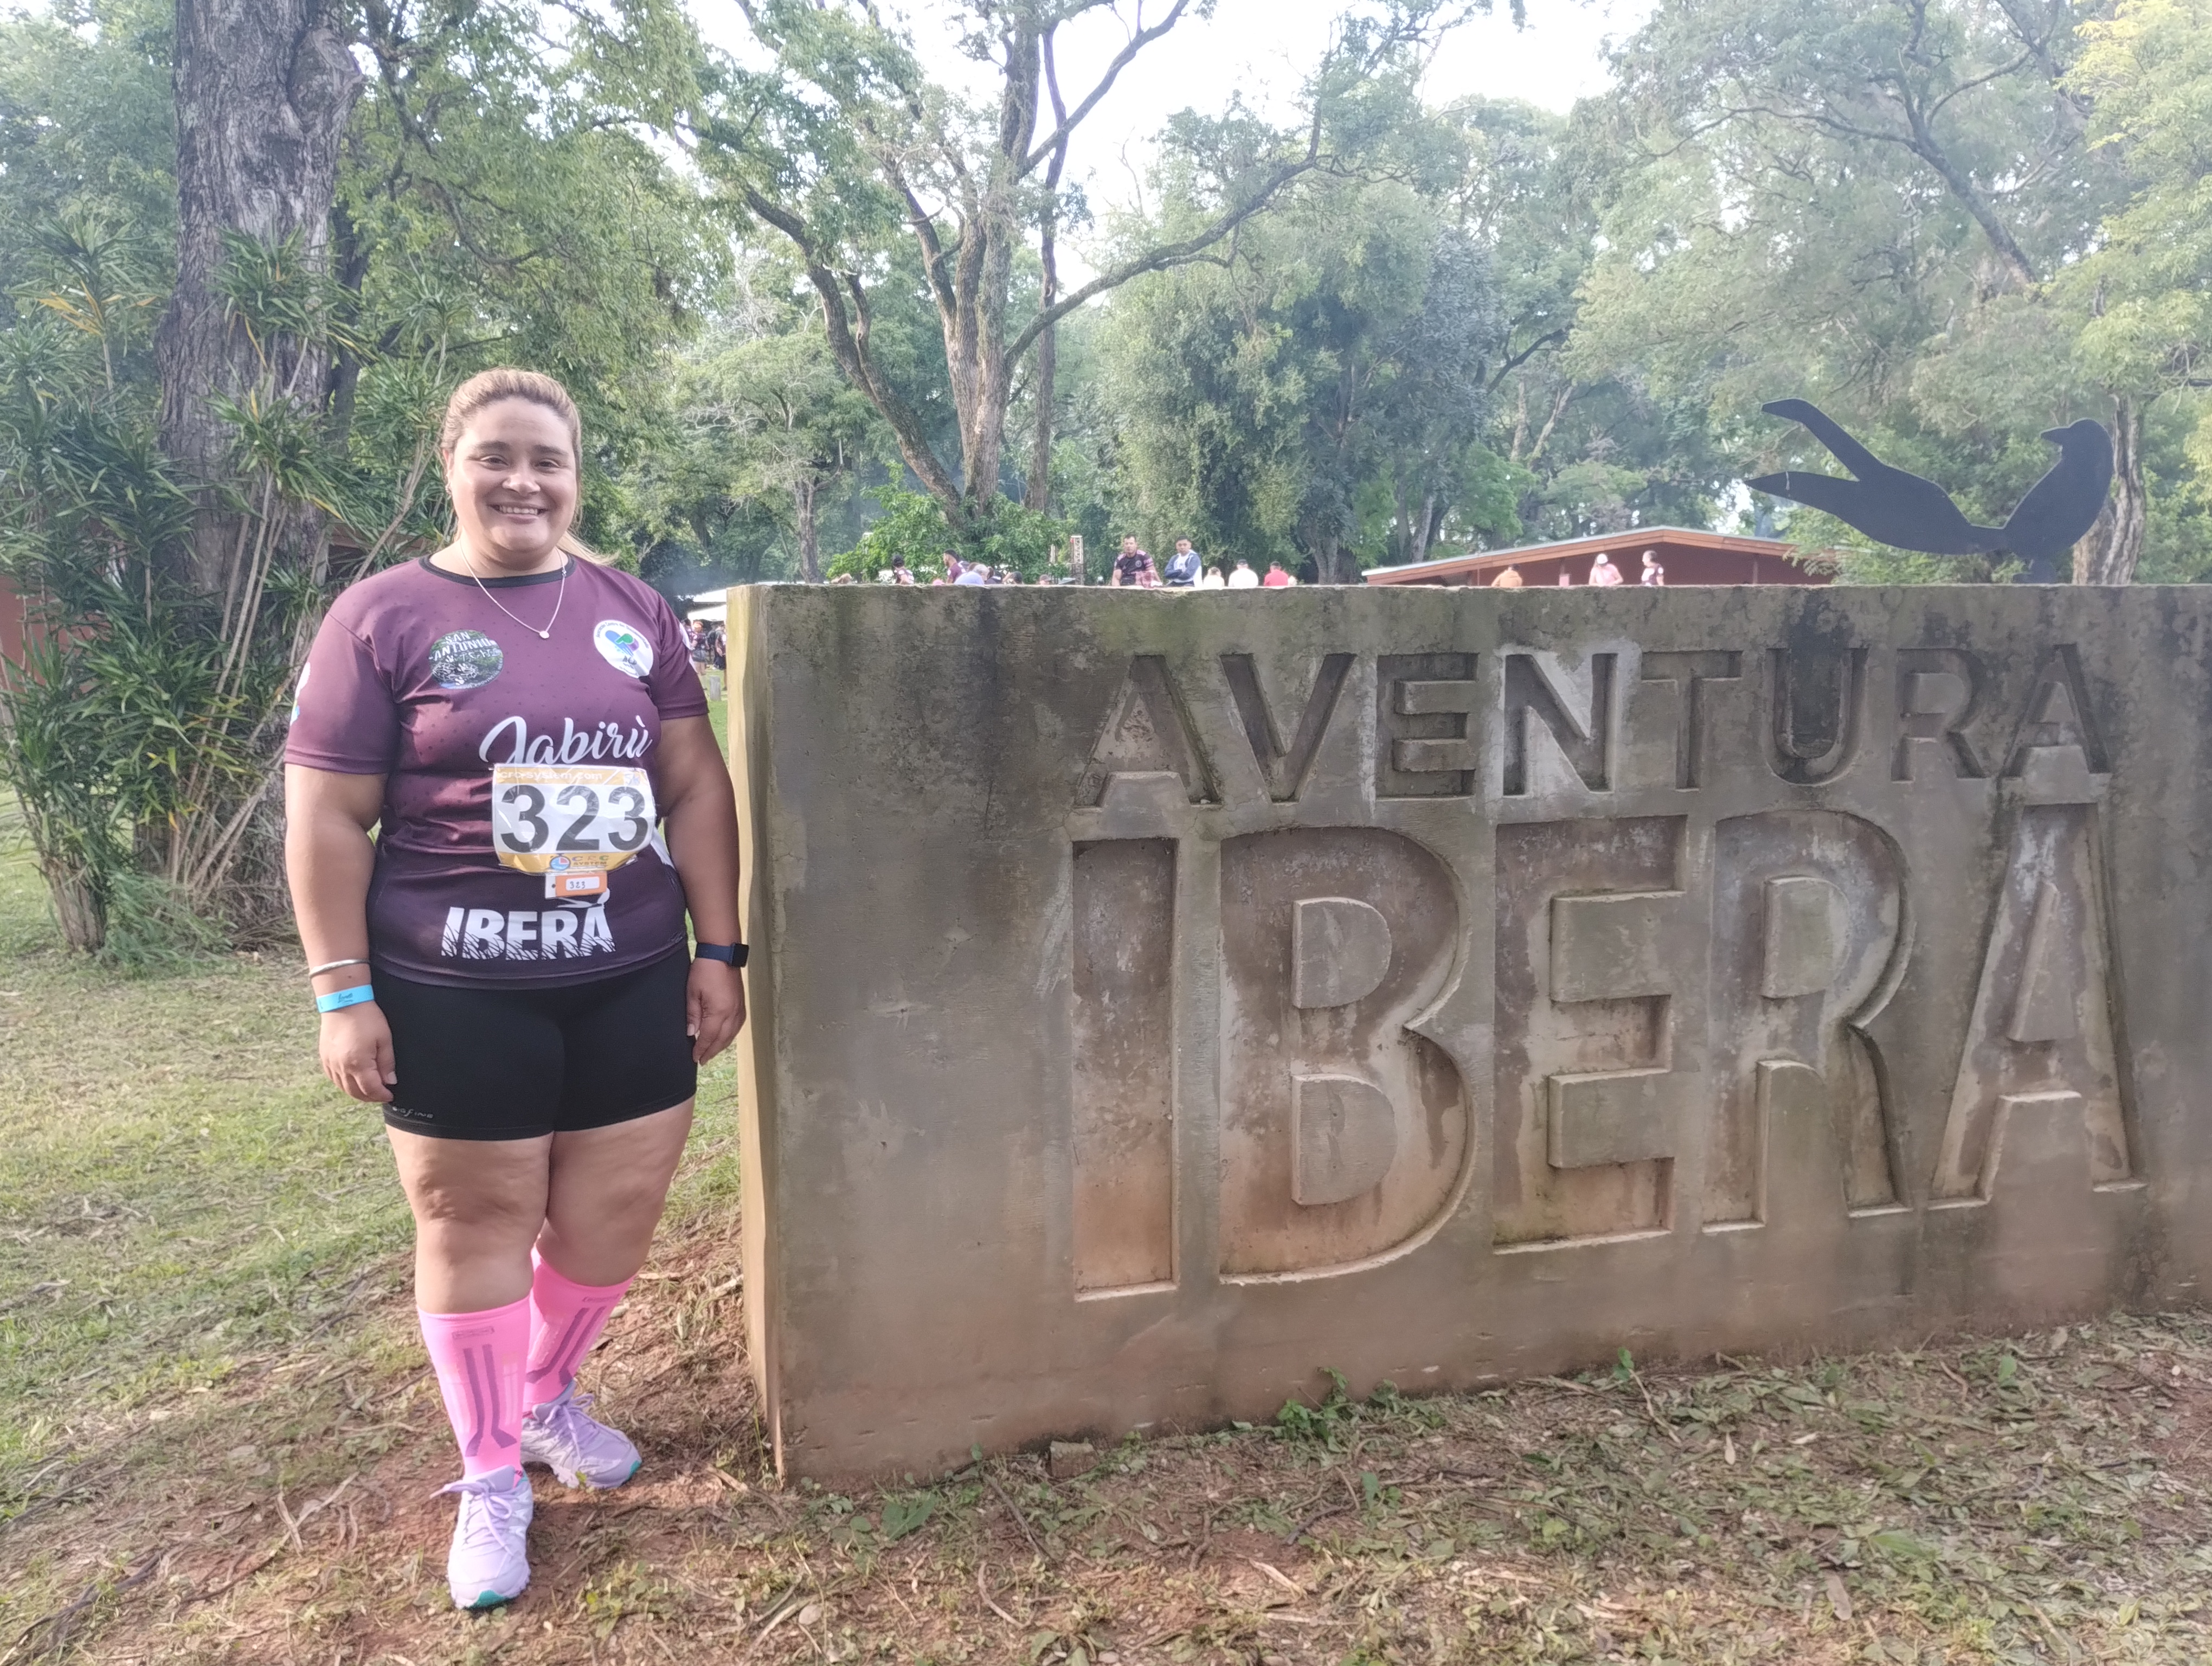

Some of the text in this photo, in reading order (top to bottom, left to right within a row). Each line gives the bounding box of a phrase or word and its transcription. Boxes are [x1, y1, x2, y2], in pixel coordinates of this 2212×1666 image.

[445, 631, 471, 644] SAN
[1071, 644, 2112, 813] AVENTURA
[500, 785, 648, 853] 323
[569, 881, 586, 889] 323
